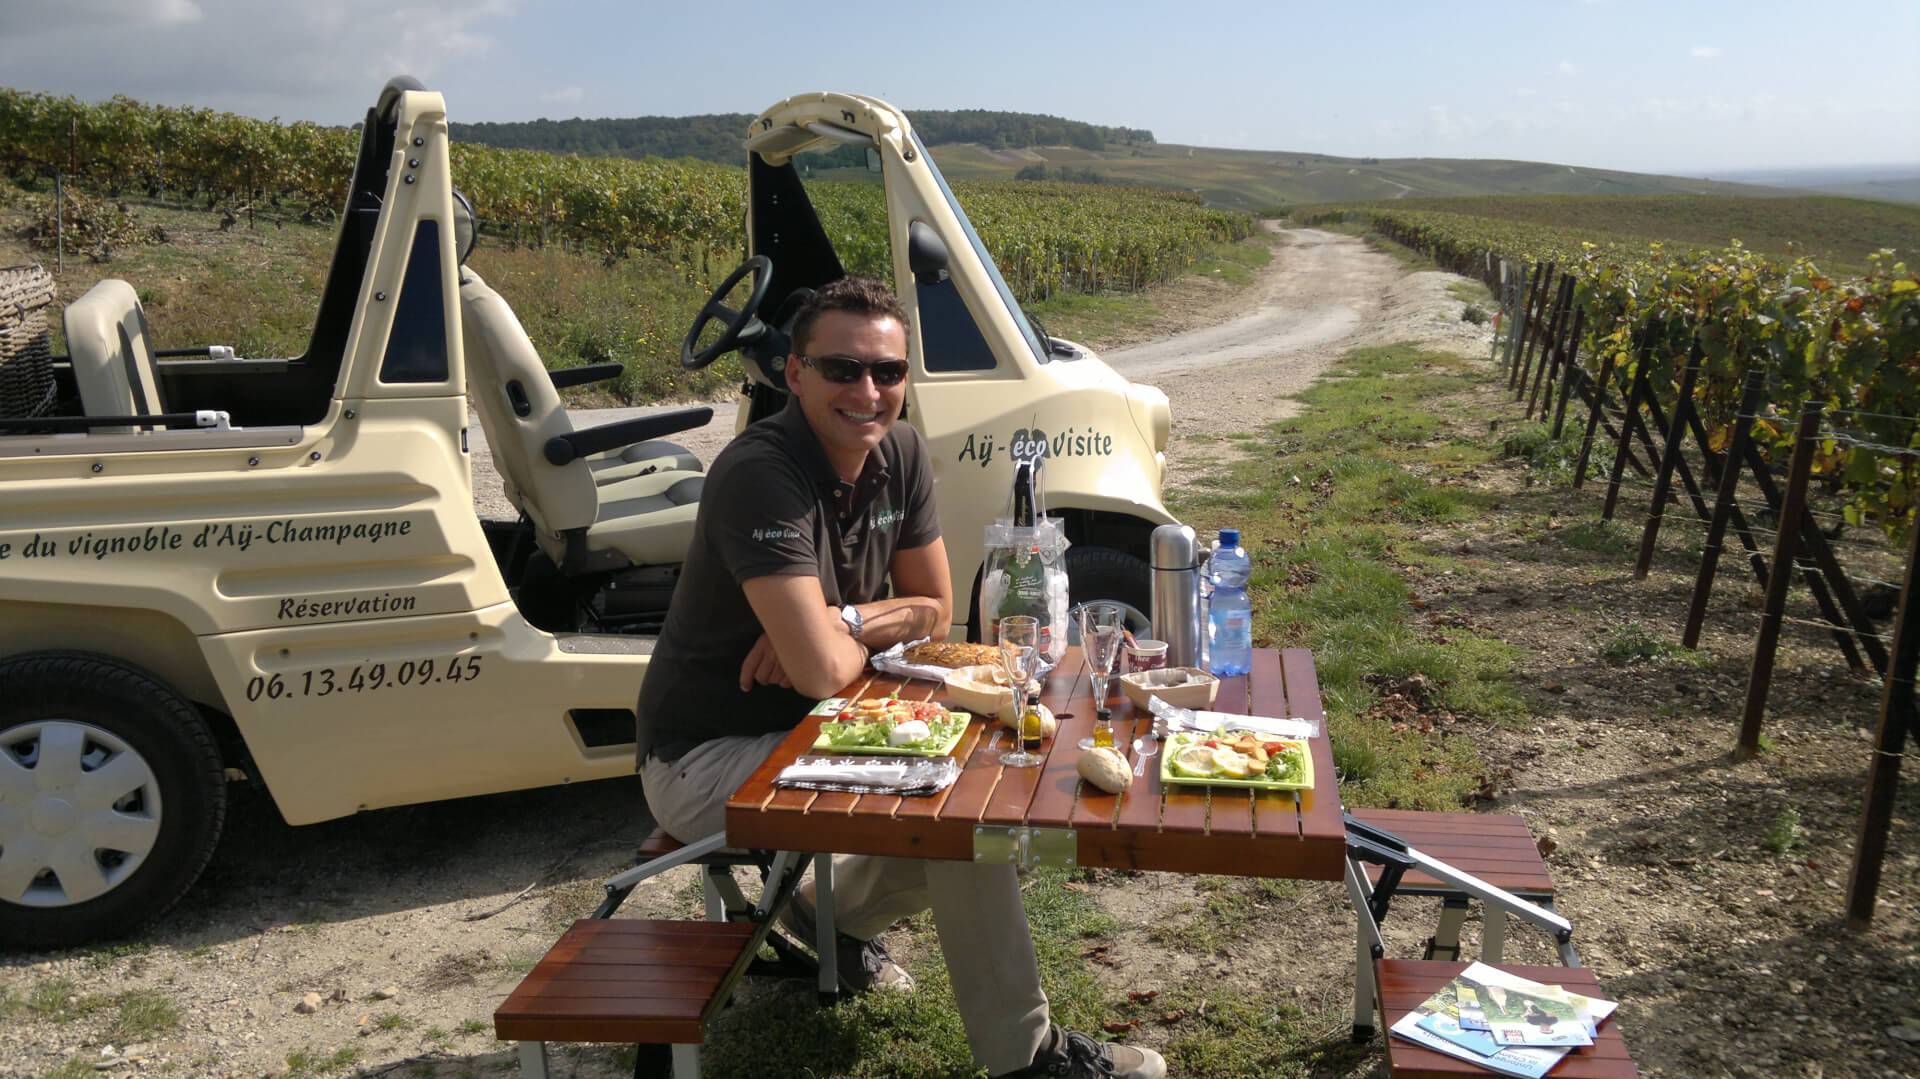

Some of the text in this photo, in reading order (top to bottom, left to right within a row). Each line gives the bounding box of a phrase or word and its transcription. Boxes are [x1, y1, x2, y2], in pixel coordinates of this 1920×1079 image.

[22, 533, 57, 558] du
[68, 526, 183, 560] vignoble
[277, 592, 417, 620] Réservation
[246, 655, 483, 702] 06.13.49.09.45
